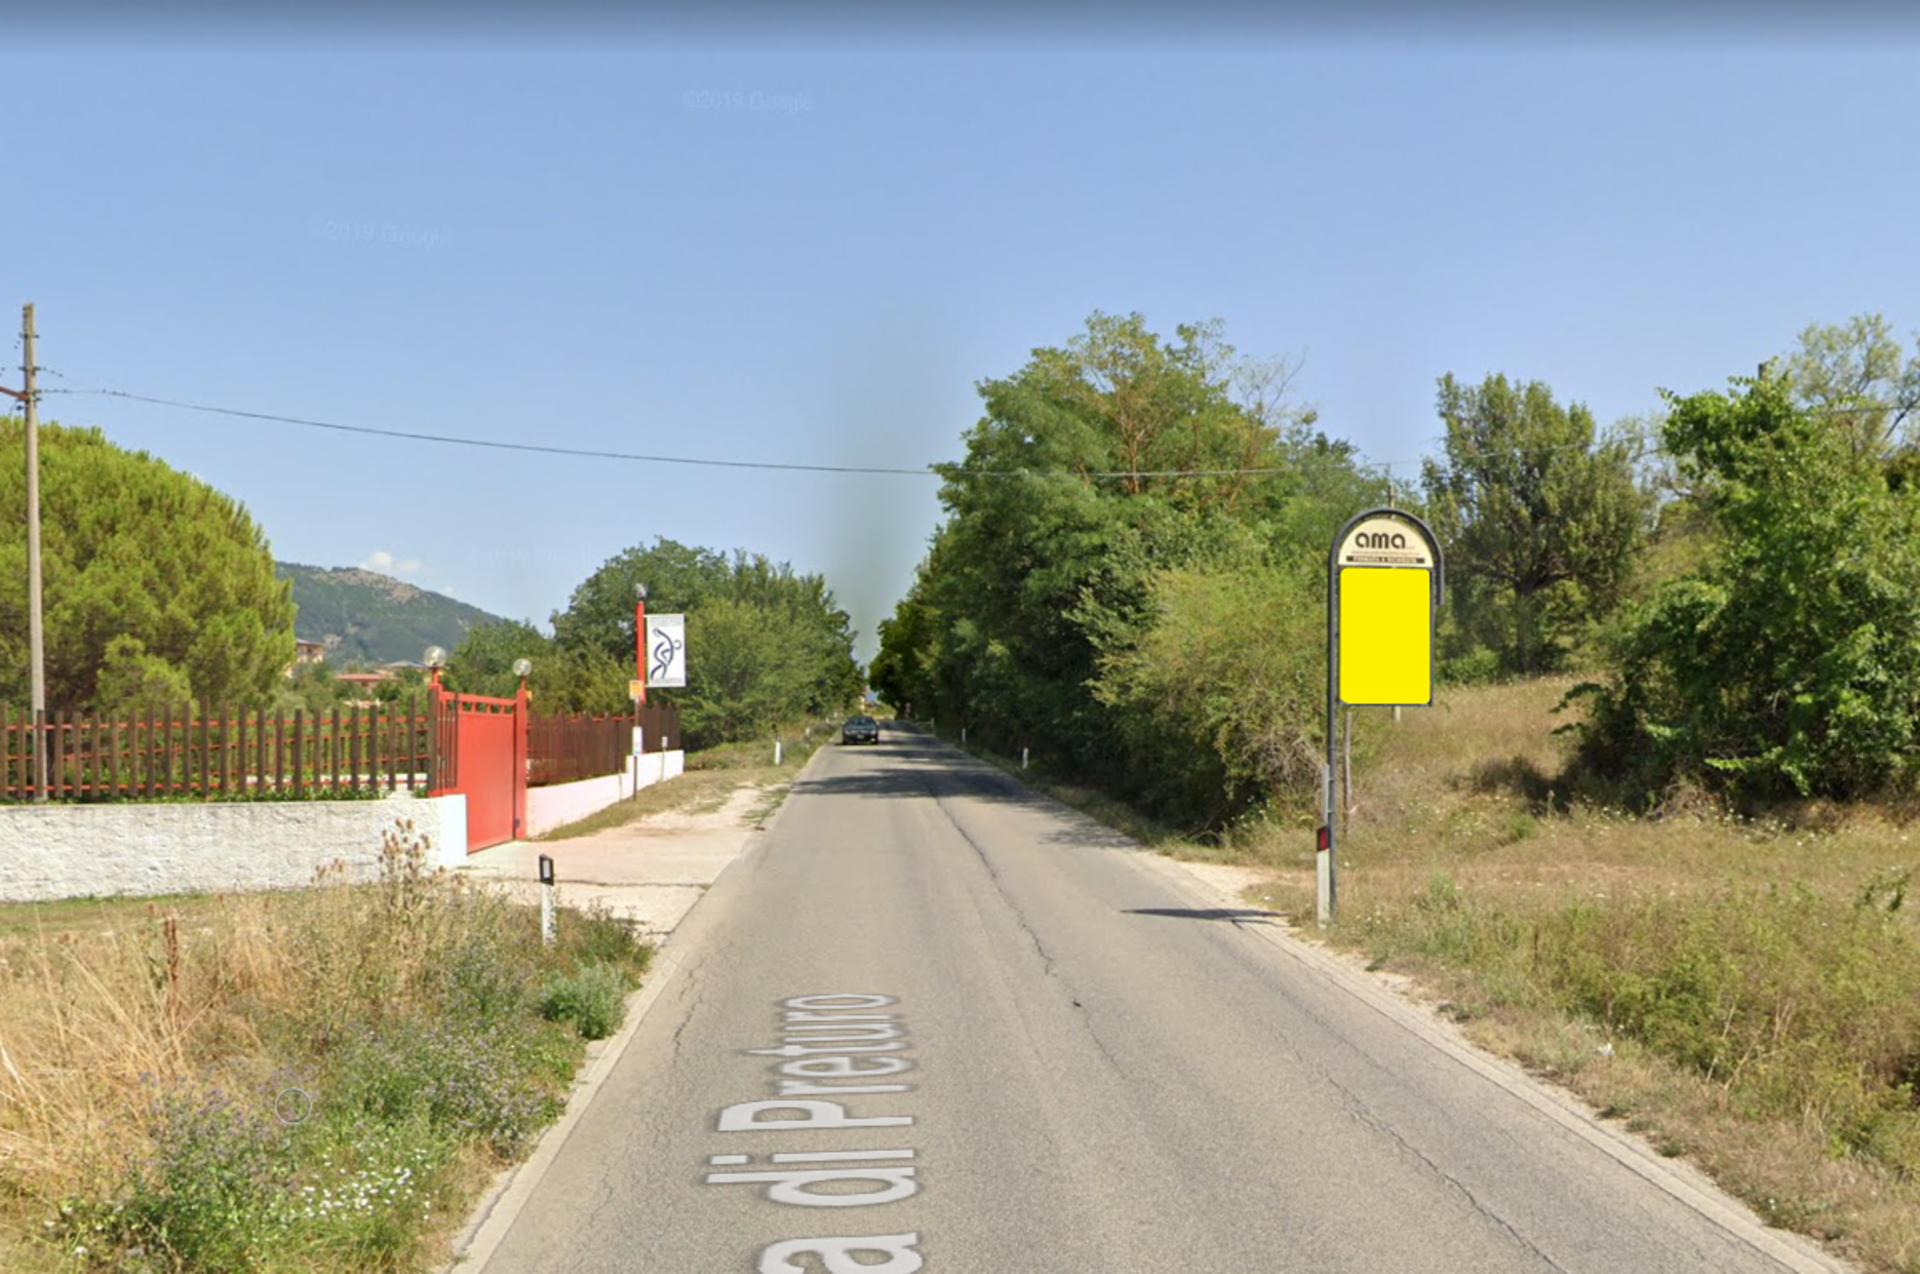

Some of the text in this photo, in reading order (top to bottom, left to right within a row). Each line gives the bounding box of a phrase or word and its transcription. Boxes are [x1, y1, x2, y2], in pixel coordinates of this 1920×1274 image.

[1355, 532, 1405, 549] ama
[716, 993, 914, 1132] Preturo
[706, 1149, 918, 1206] di
